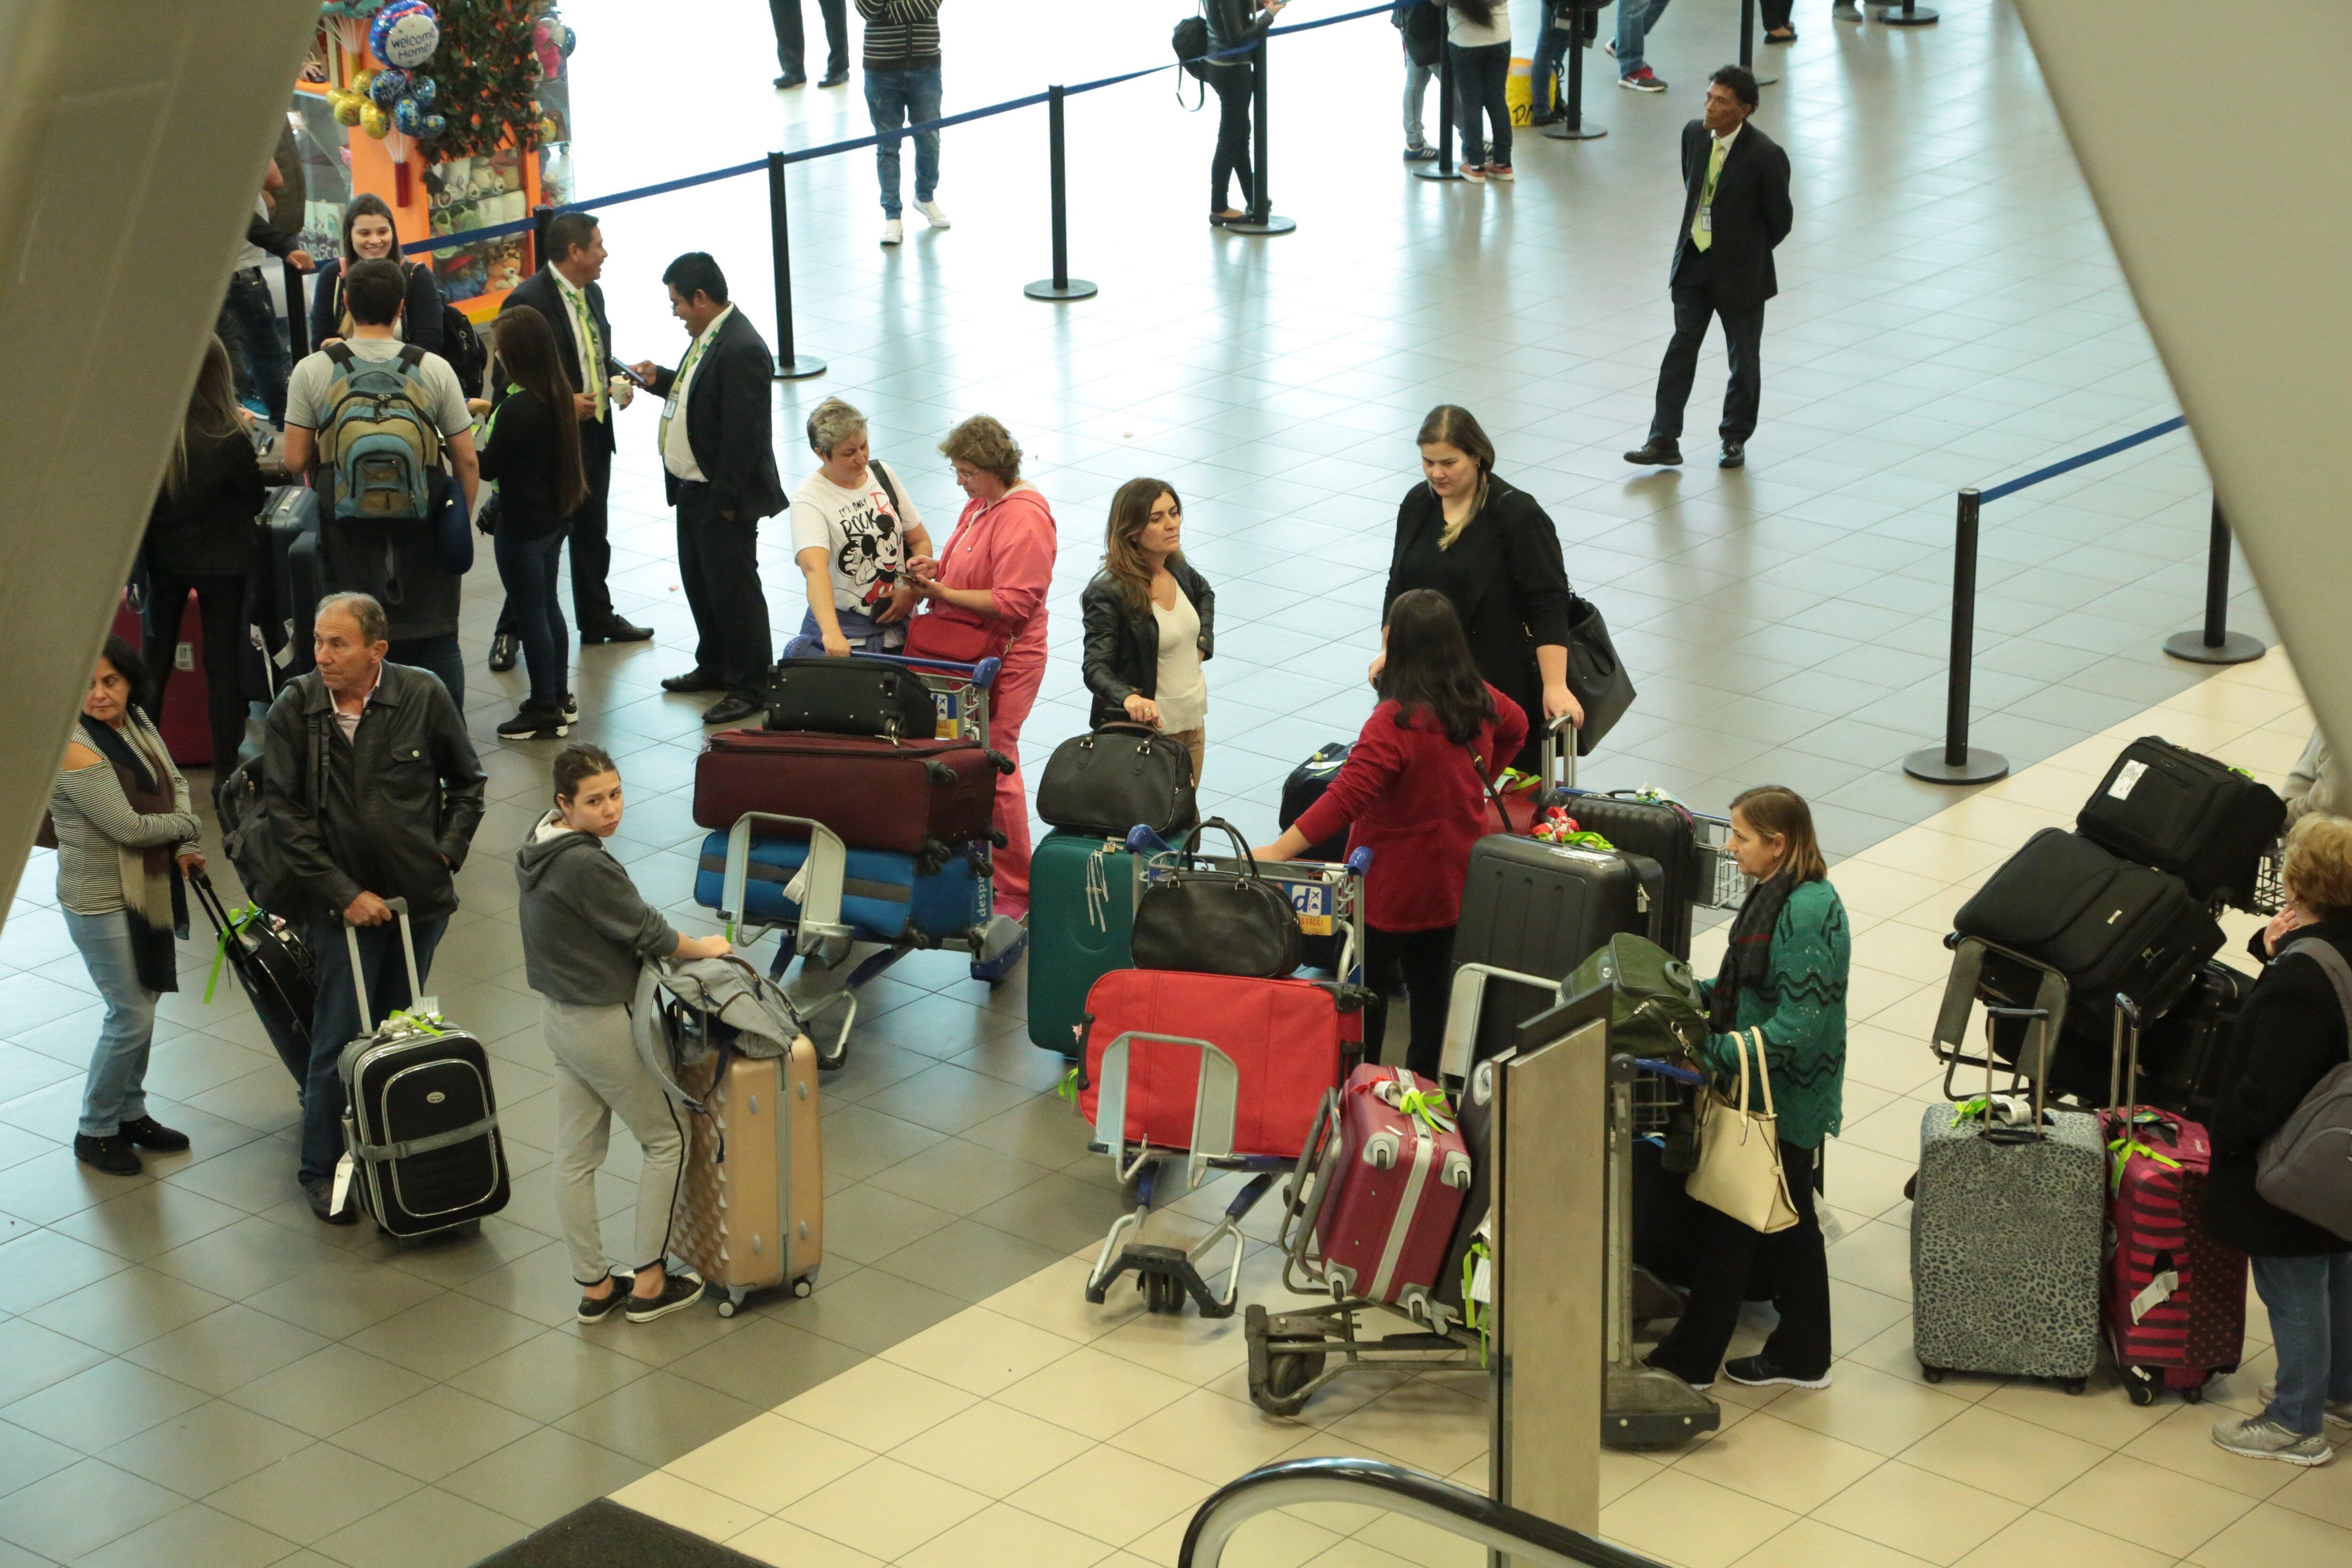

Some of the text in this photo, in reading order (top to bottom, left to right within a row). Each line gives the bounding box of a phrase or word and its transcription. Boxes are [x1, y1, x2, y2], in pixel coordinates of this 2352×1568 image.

[852, 498, 869, 511] ONLY
[840, 508, 877, 541] ROCK
[976, 851, 988, 917] desper
